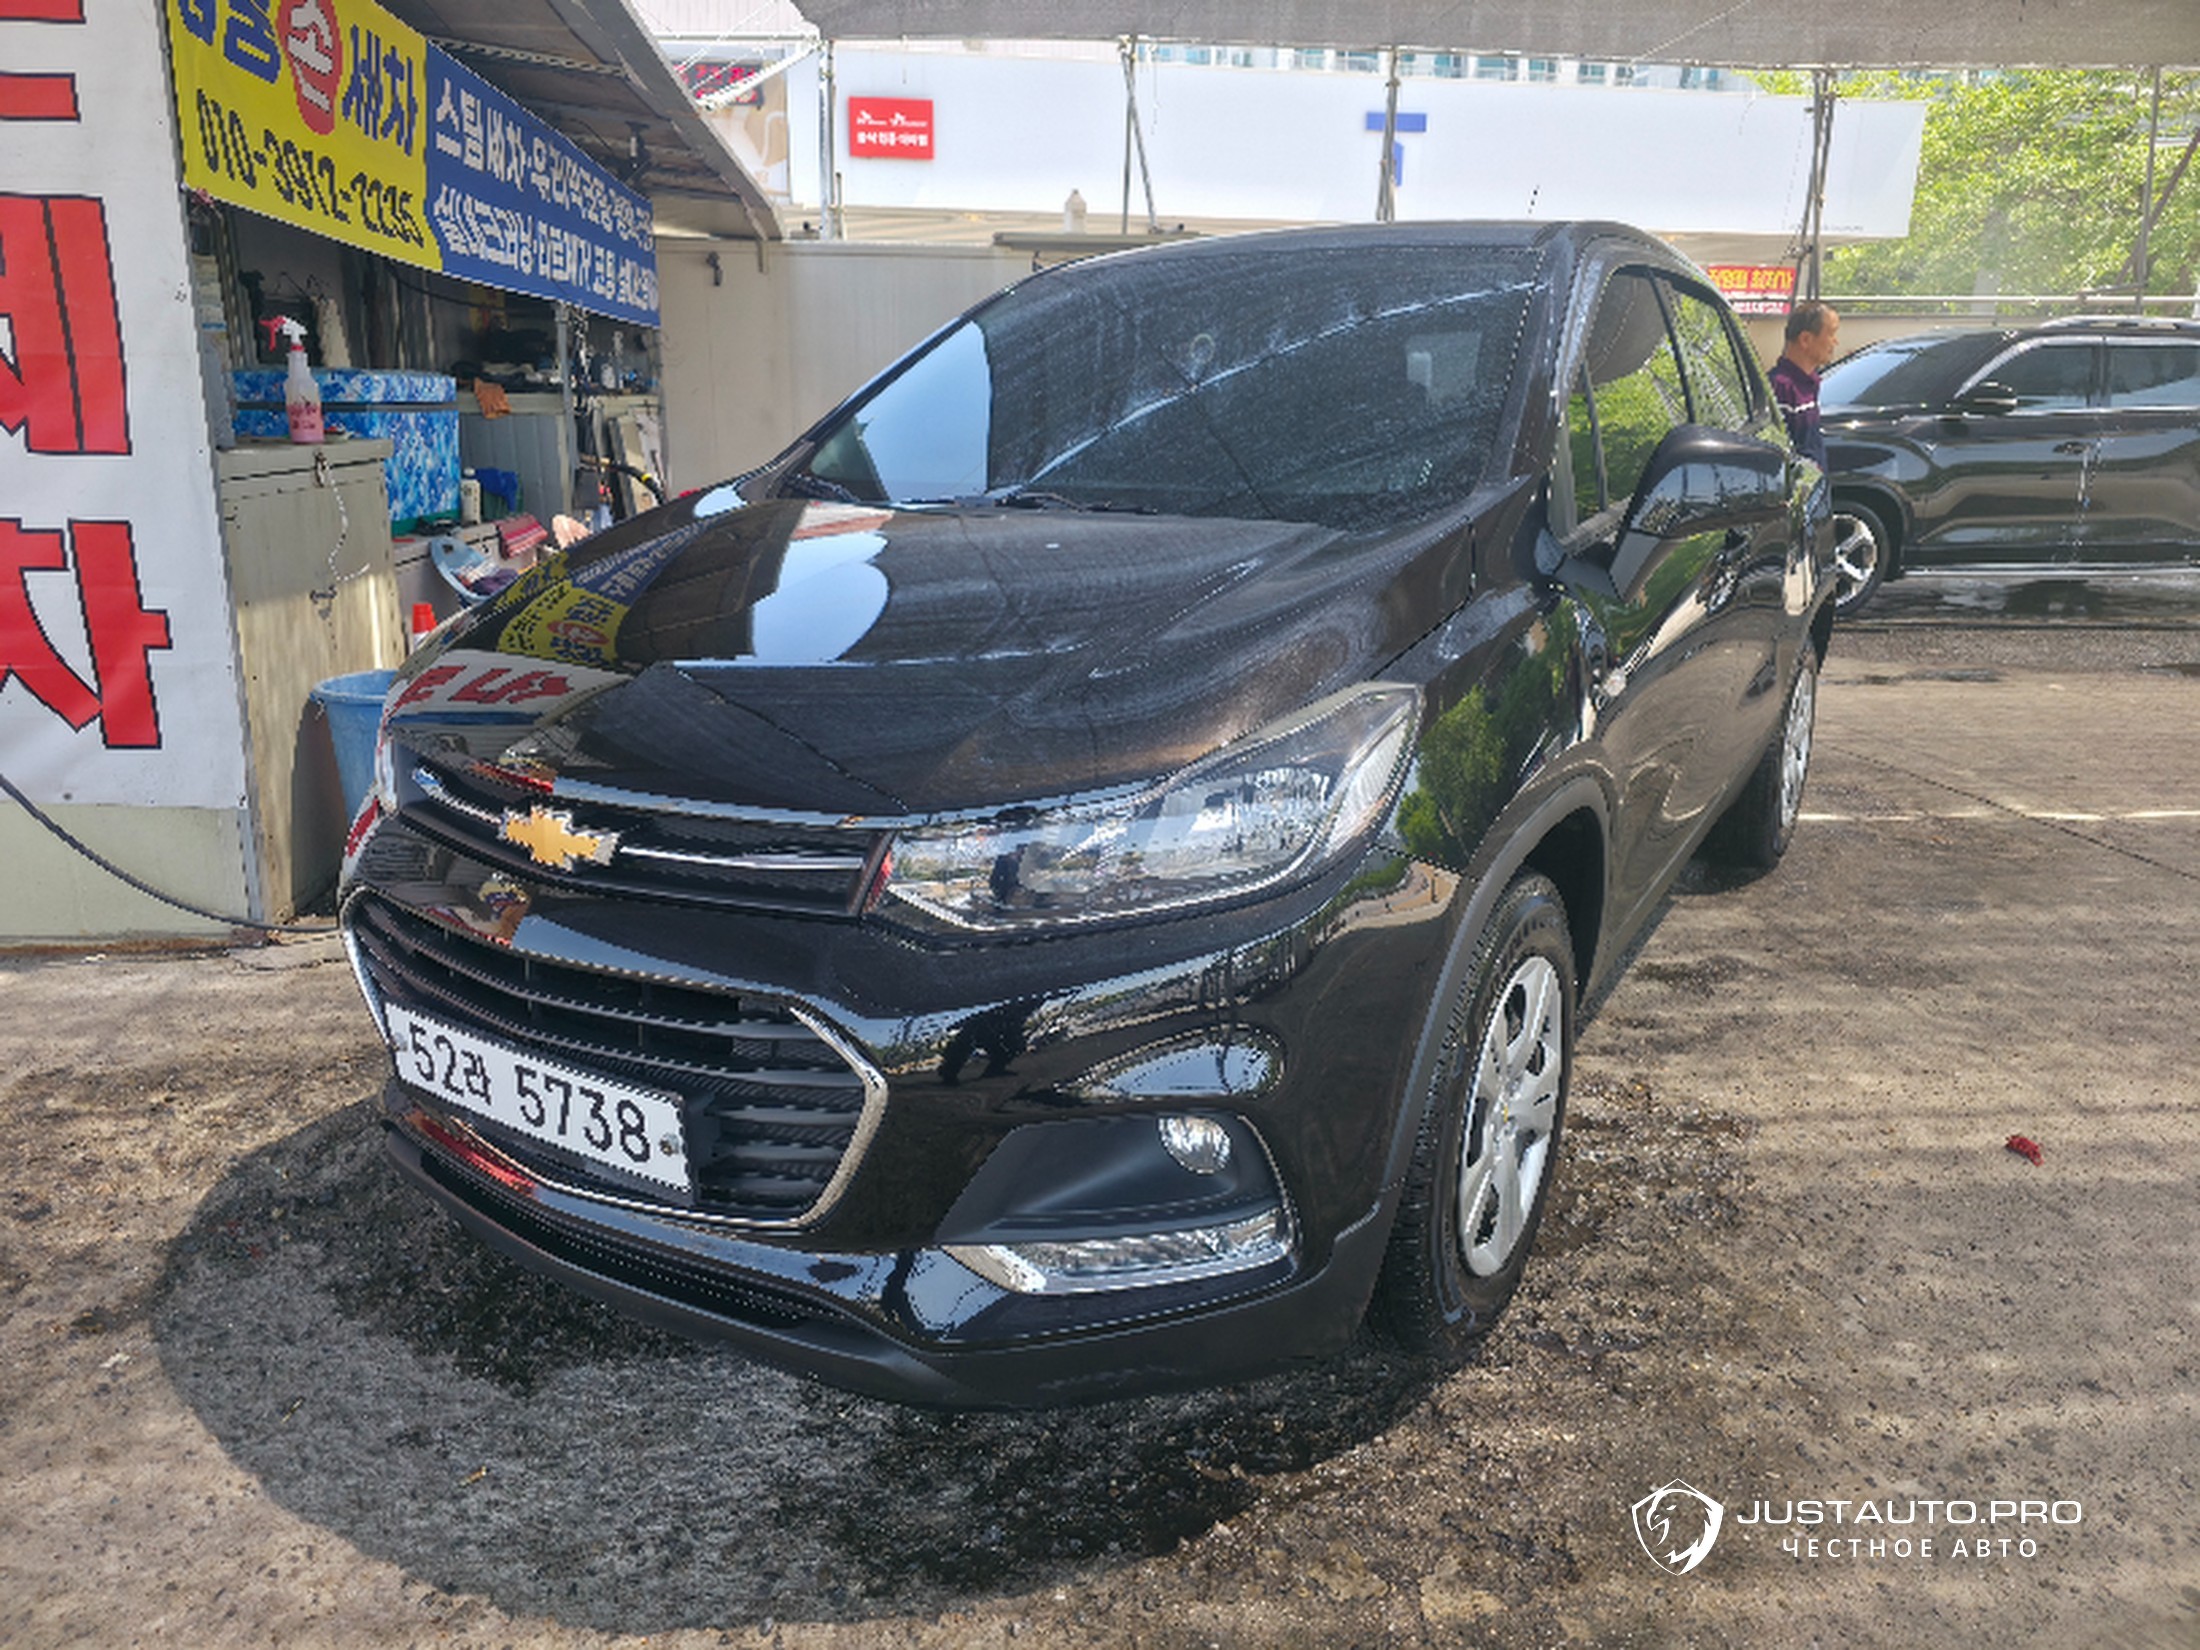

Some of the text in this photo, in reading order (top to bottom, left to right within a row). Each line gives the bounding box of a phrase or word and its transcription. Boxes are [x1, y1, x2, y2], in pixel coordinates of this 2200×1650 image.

[197, 87, 424, 248] 010-3912-2235
[409, 1021, 651, 1163] 52라 5738
